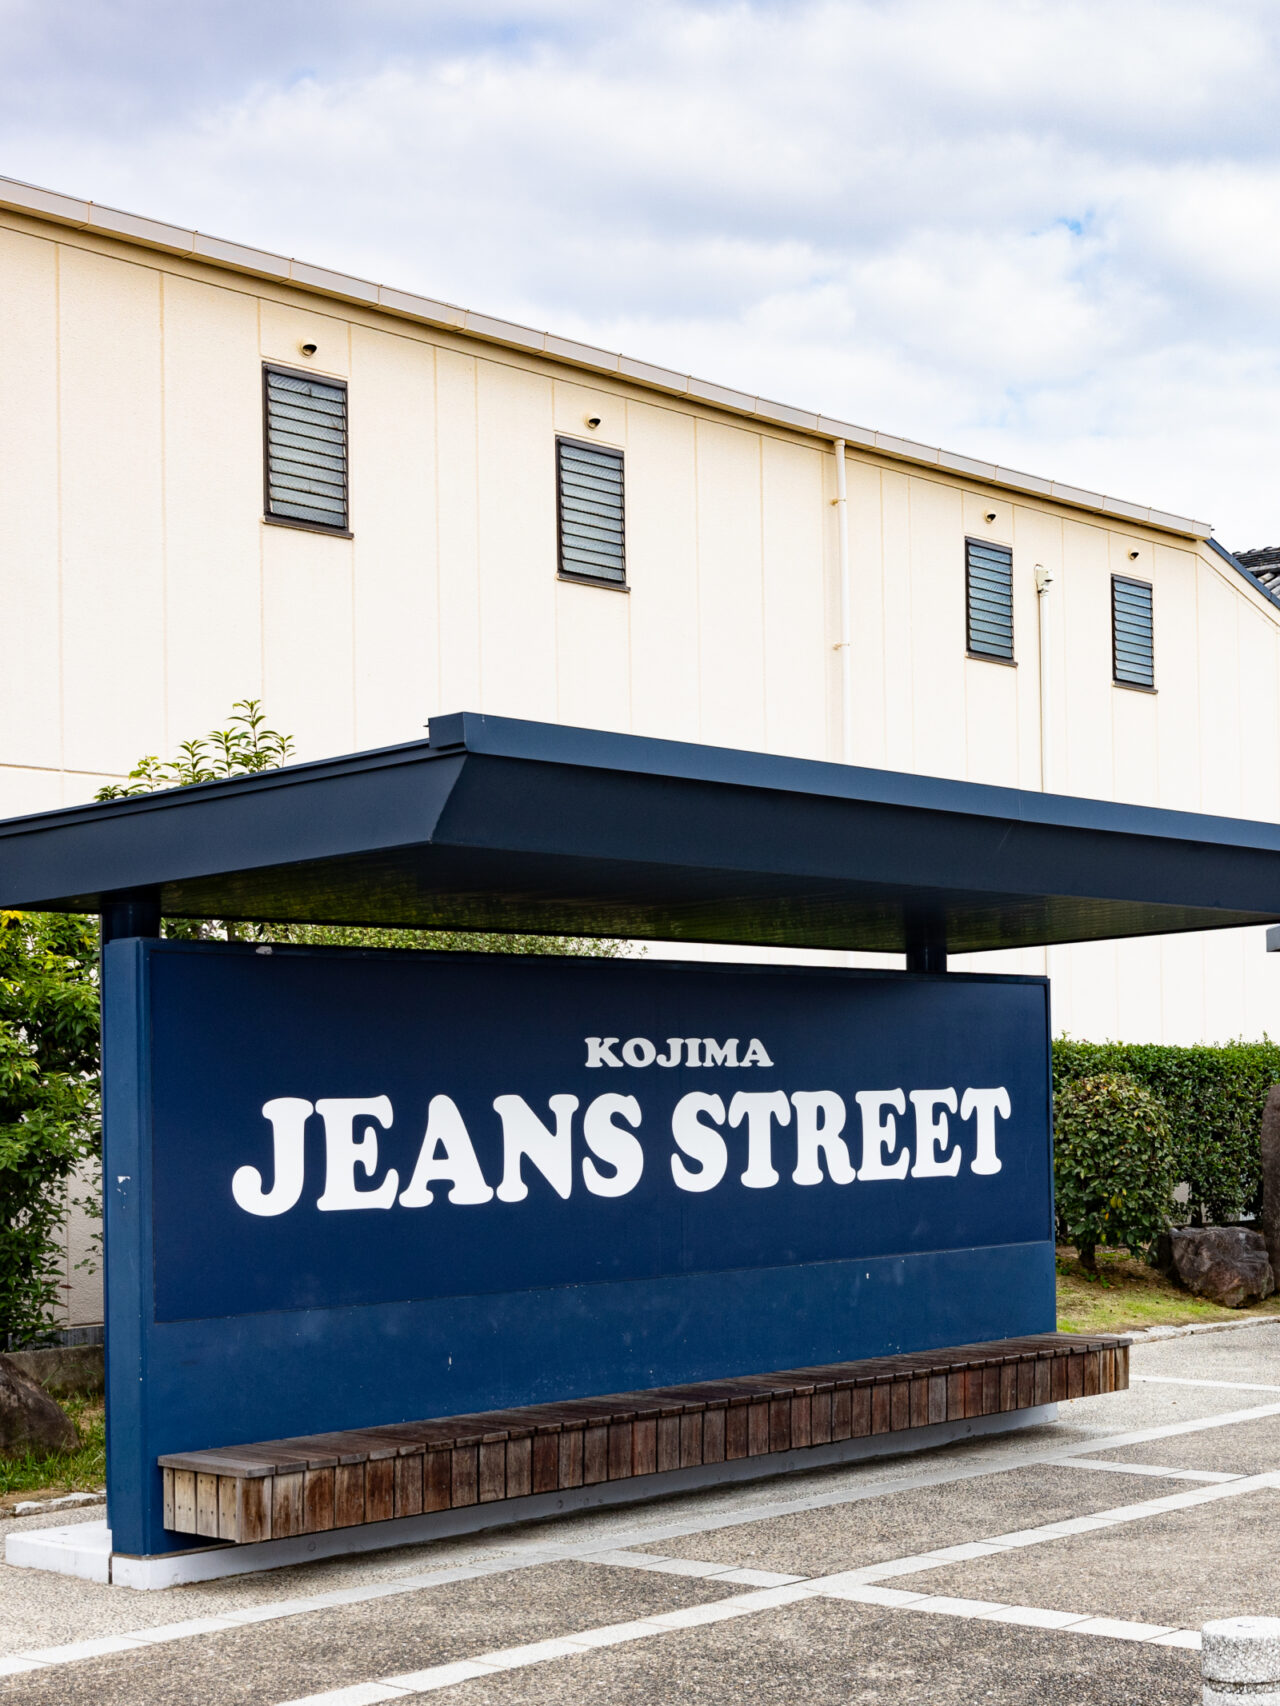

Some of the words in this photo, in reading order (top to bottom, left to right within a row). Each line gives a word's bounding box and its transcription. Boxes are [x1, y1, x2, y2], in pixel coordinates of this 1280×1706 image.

[584, 1036, 775, 1069] KOJIMA
[230, 1090, 645, 1218] JEANS
[669, 1085, 1013, 1195] STREET
